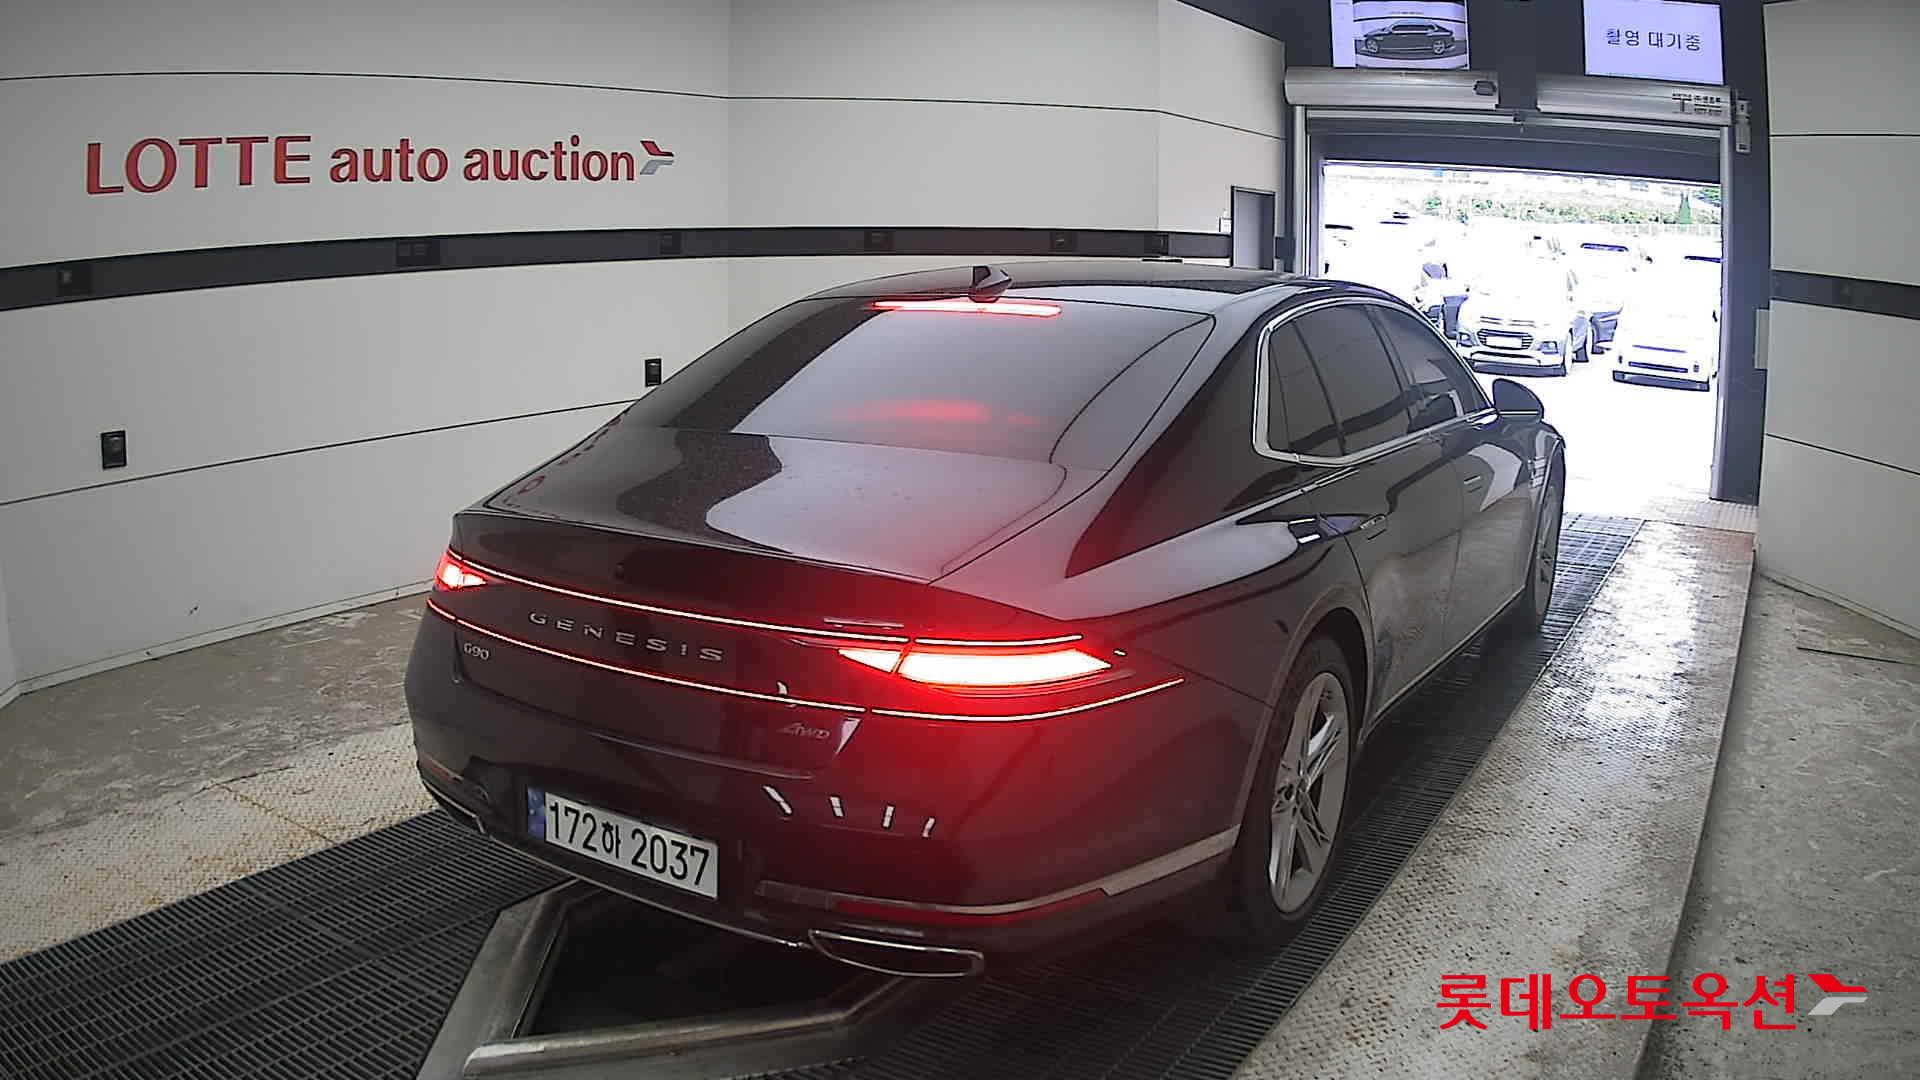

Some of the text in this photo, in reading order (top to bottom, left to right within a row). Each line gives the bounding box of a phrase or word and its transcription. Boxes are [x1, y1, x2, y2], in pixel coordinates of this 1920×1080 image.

[1648, 31, 1700, 52] 대기중
[86, 134, 635, 195] LOTTE auto auction
[463, 642, 489, 661] G90
[529, 612, 723, 662] GENESIS
[549, 801, 710, 886] 172하 2037
